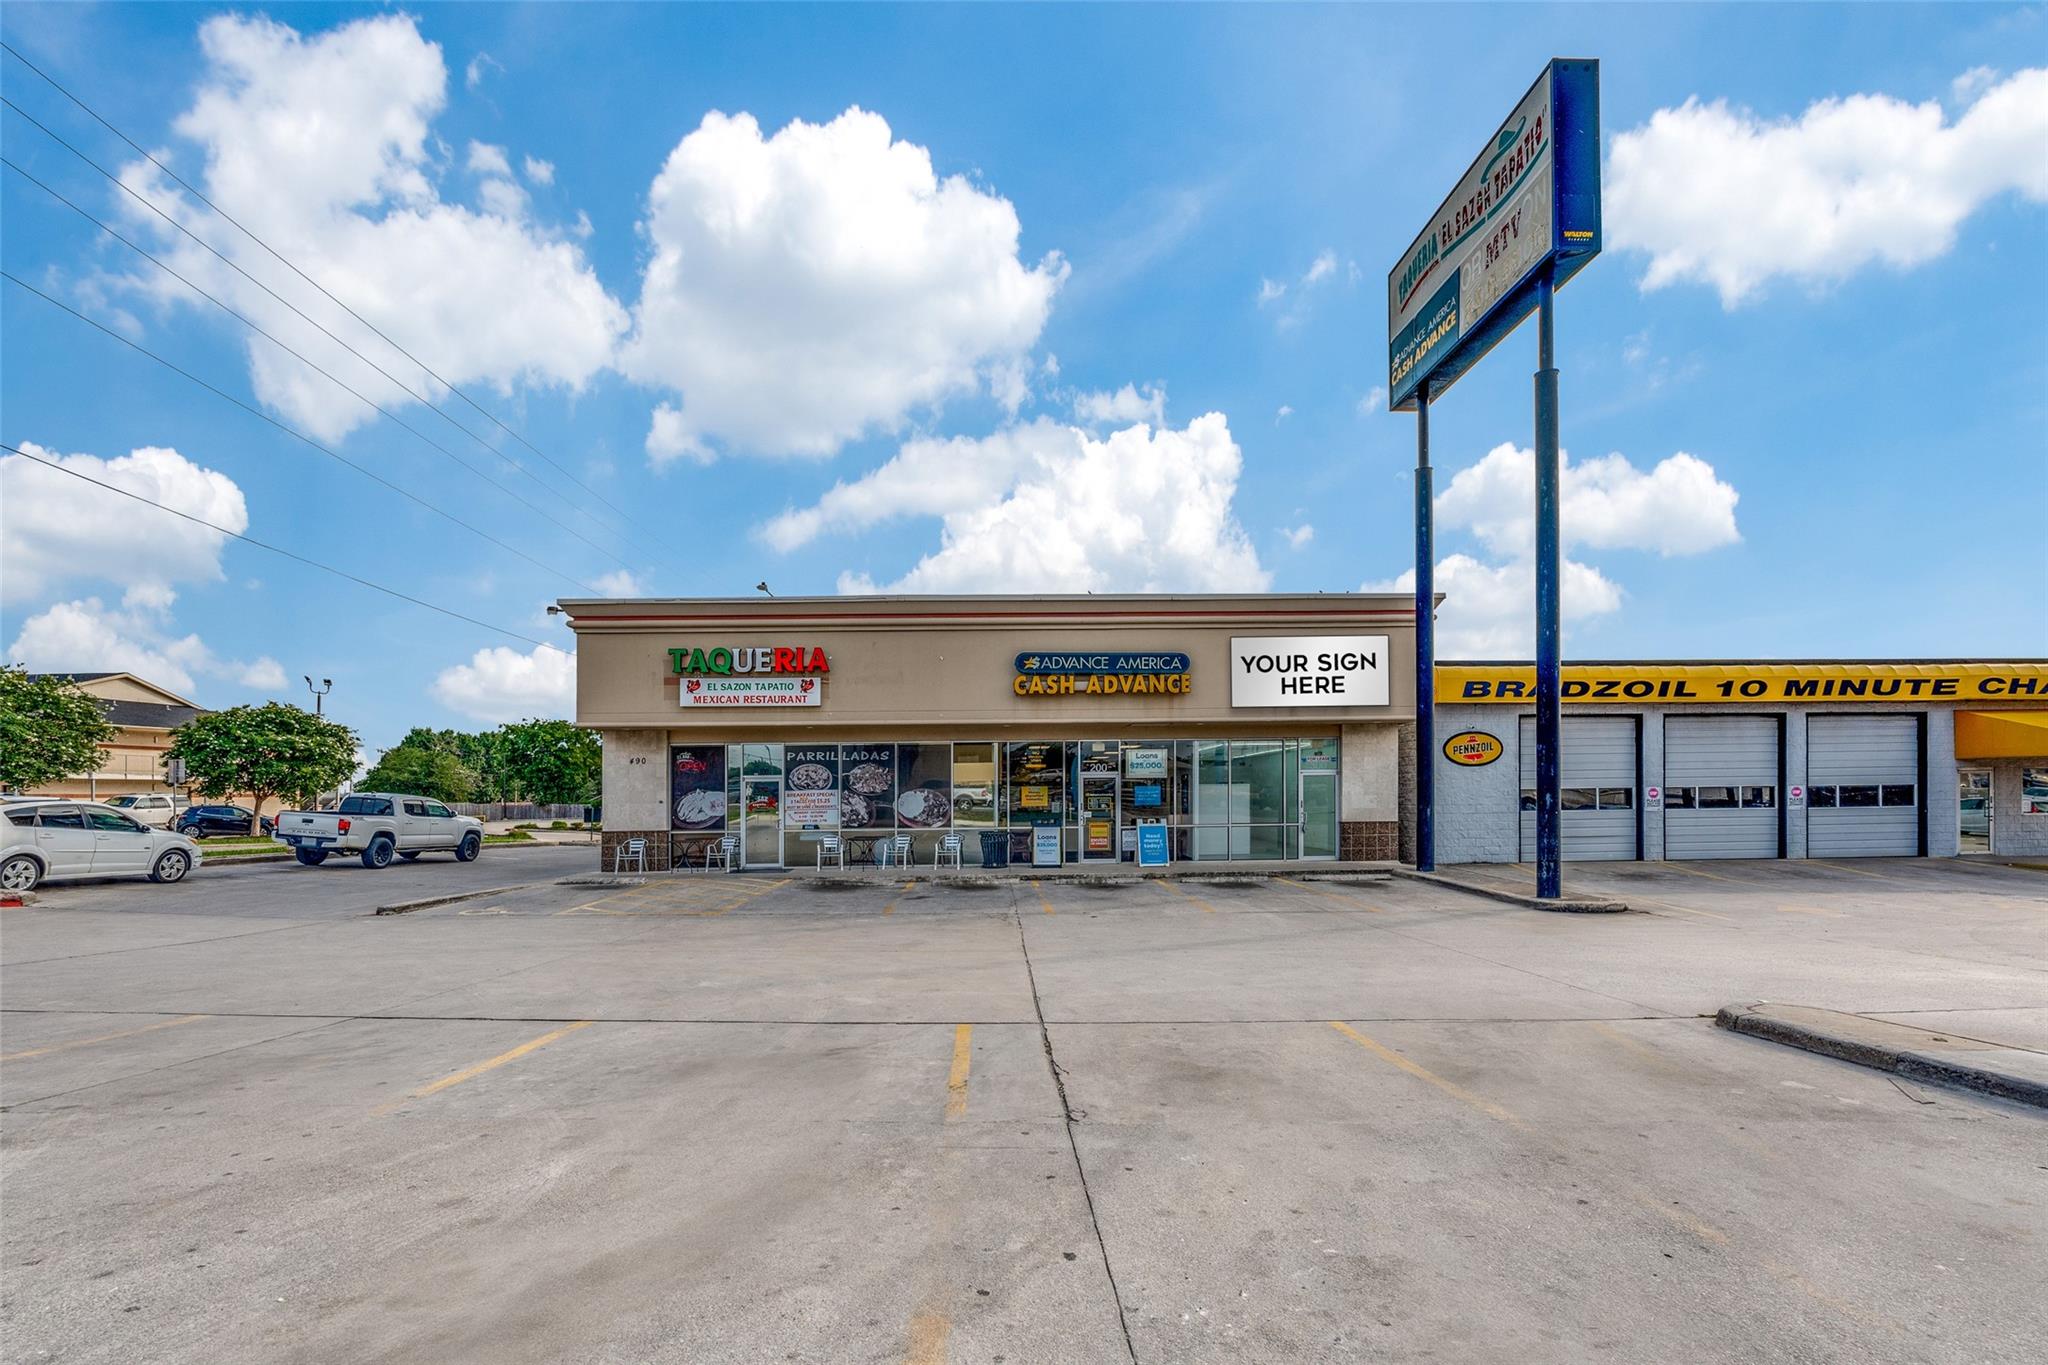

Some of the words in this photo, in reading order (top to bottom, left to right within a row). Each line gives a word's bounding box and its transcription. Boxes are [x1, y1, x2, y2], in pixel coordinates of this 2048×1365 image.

[1398, 232, 1438, 304] TAQUERIA
[1455, 181, 1492, 237] SAZON
[1399, 326, 1426, 360] ADVANCE
[1426, 296, 1456, 333] AMERICA
[1391, 355, 1414, 386] CASH
[1414, 309, 1457, 364] ADVANCE
[668, 646, 830, 675] TAQUERIA
[1041, 656, 1110, 670] ADVANCE
[1116, 656, 1182, 670] AMERICA
[1241, 655, 1308, 673] YOUR
[1318, 652, 1377, 672] SIGN
[707, 683, 718, 691] EL
[720, 682, 753, 691] SAZON
[755, 682, 794, 691] TAPATIO
[1013, 674, 1075, 695] CASH
[1086, 674, 1192, 695] ADVANCE
[1281, 675, 1345, 695] HERE
[1716, 679, 1768, 697] 10
[1783, 678, 1960, 697] MINUTE
[693, 695, 740, 704] MEXICAN
[743, 695, 808, 704] RESTAURANT
[1452, 742, 1495, 755] PENNZOIL
[1089, 763, 1108, 772] 200
